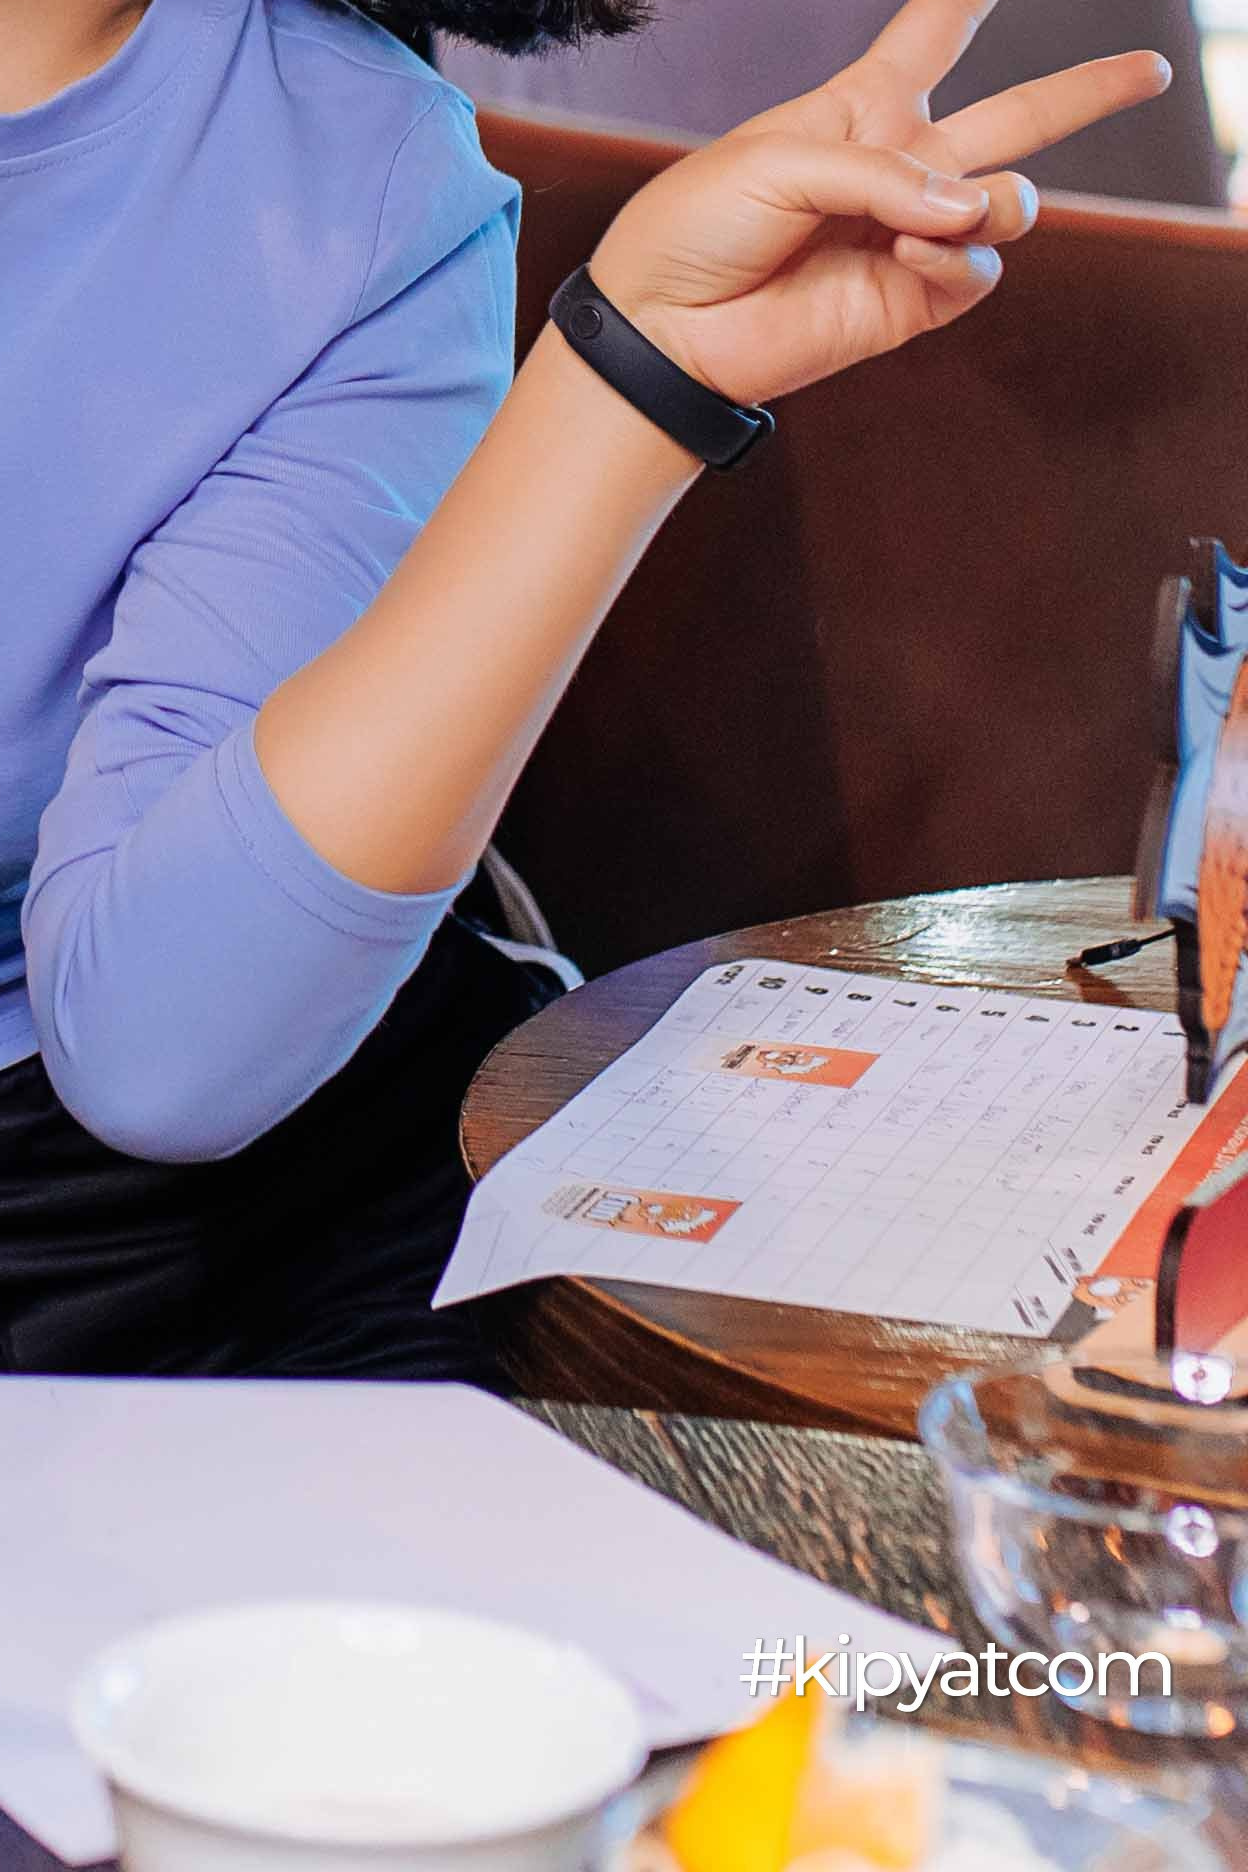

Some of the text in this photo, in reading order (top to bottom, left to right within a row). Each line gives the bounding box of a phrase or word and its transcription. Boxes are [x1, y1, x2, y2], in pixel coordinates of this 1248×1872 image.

[758, 977, 787, 990] 10
[805, 985, 829, 995] 9
[847, 993, 872, 1002] 8
[893, 999, 918, 1008] 7
[935, 1005, 960, 1013] 6
[980, 1009, 1007, 1017] 5
